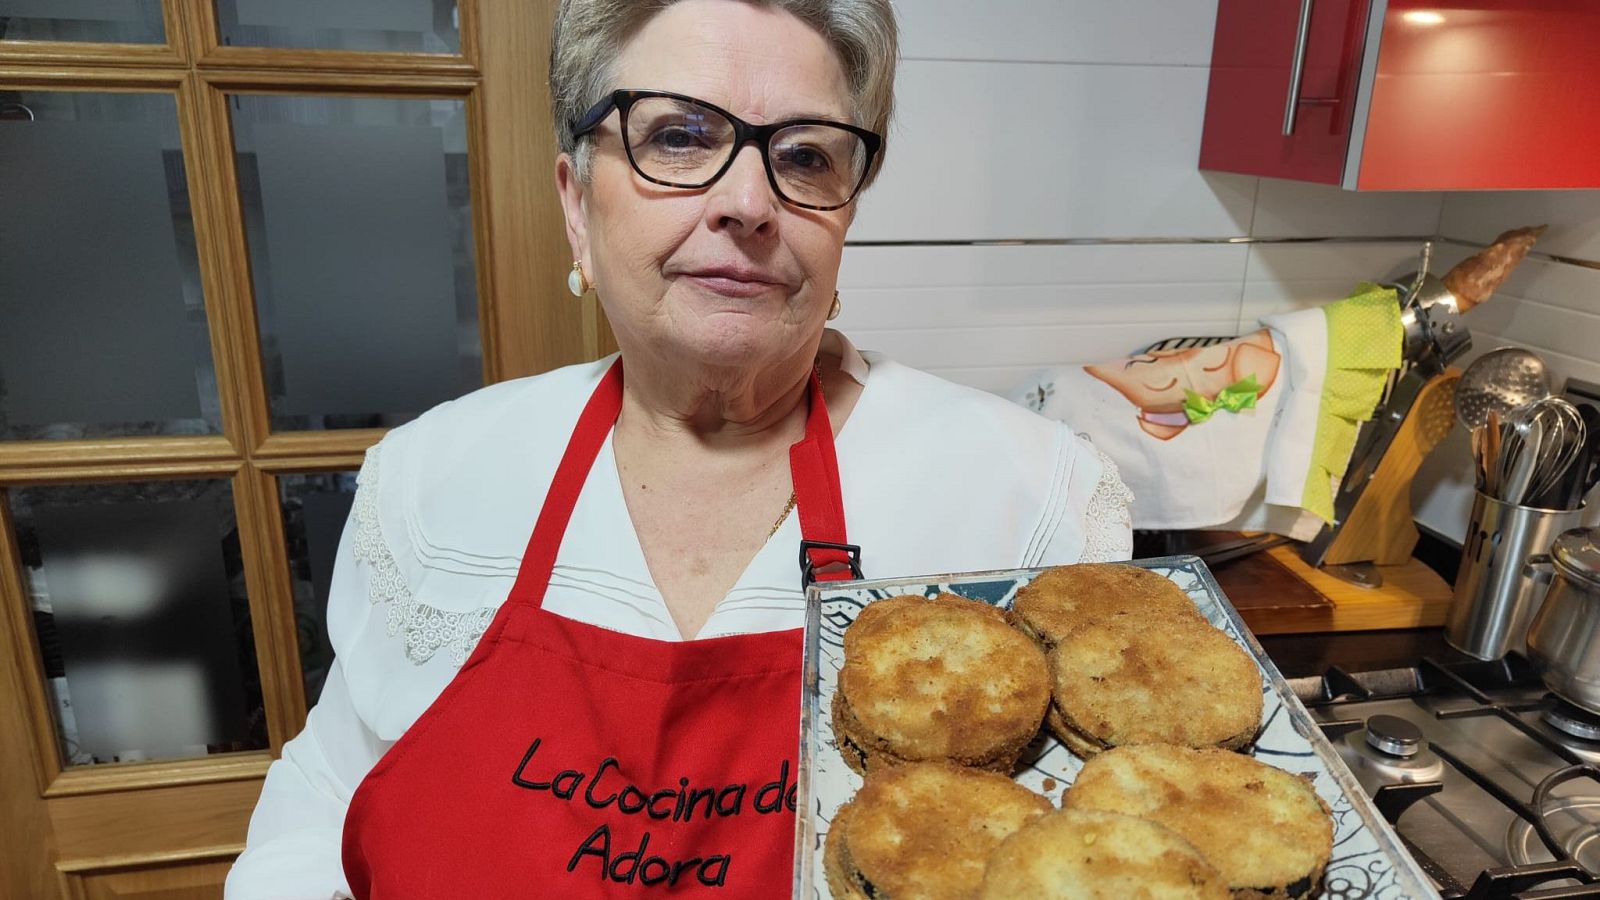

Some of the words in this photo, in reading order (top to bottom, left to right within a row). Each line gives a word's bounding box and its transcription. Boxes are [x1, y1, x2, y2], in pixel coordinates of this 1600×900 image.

[511, 738, 585, 801] La
[585, 757, 747, 823] Cocina
[566, 823, 731, 888] Adora
